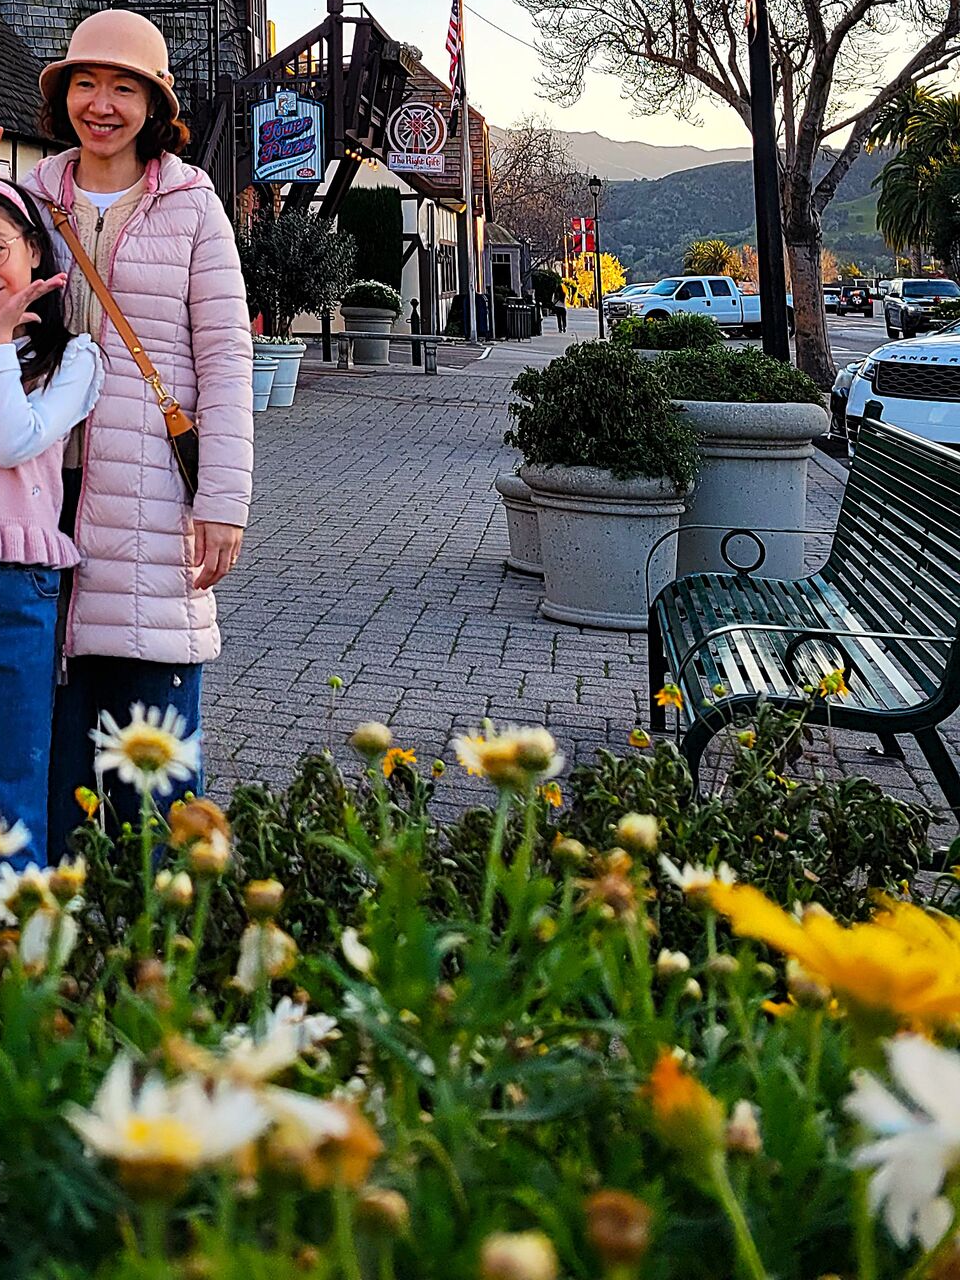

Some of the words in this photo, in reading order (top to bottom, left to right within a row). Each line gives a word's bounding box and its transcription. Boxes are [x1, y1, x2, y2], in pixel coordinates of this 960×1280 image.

[261, 117, 313, 142] Tower
[260, 137, 315, 164] Pizza
[890, 354, 940, 362] RANGE
